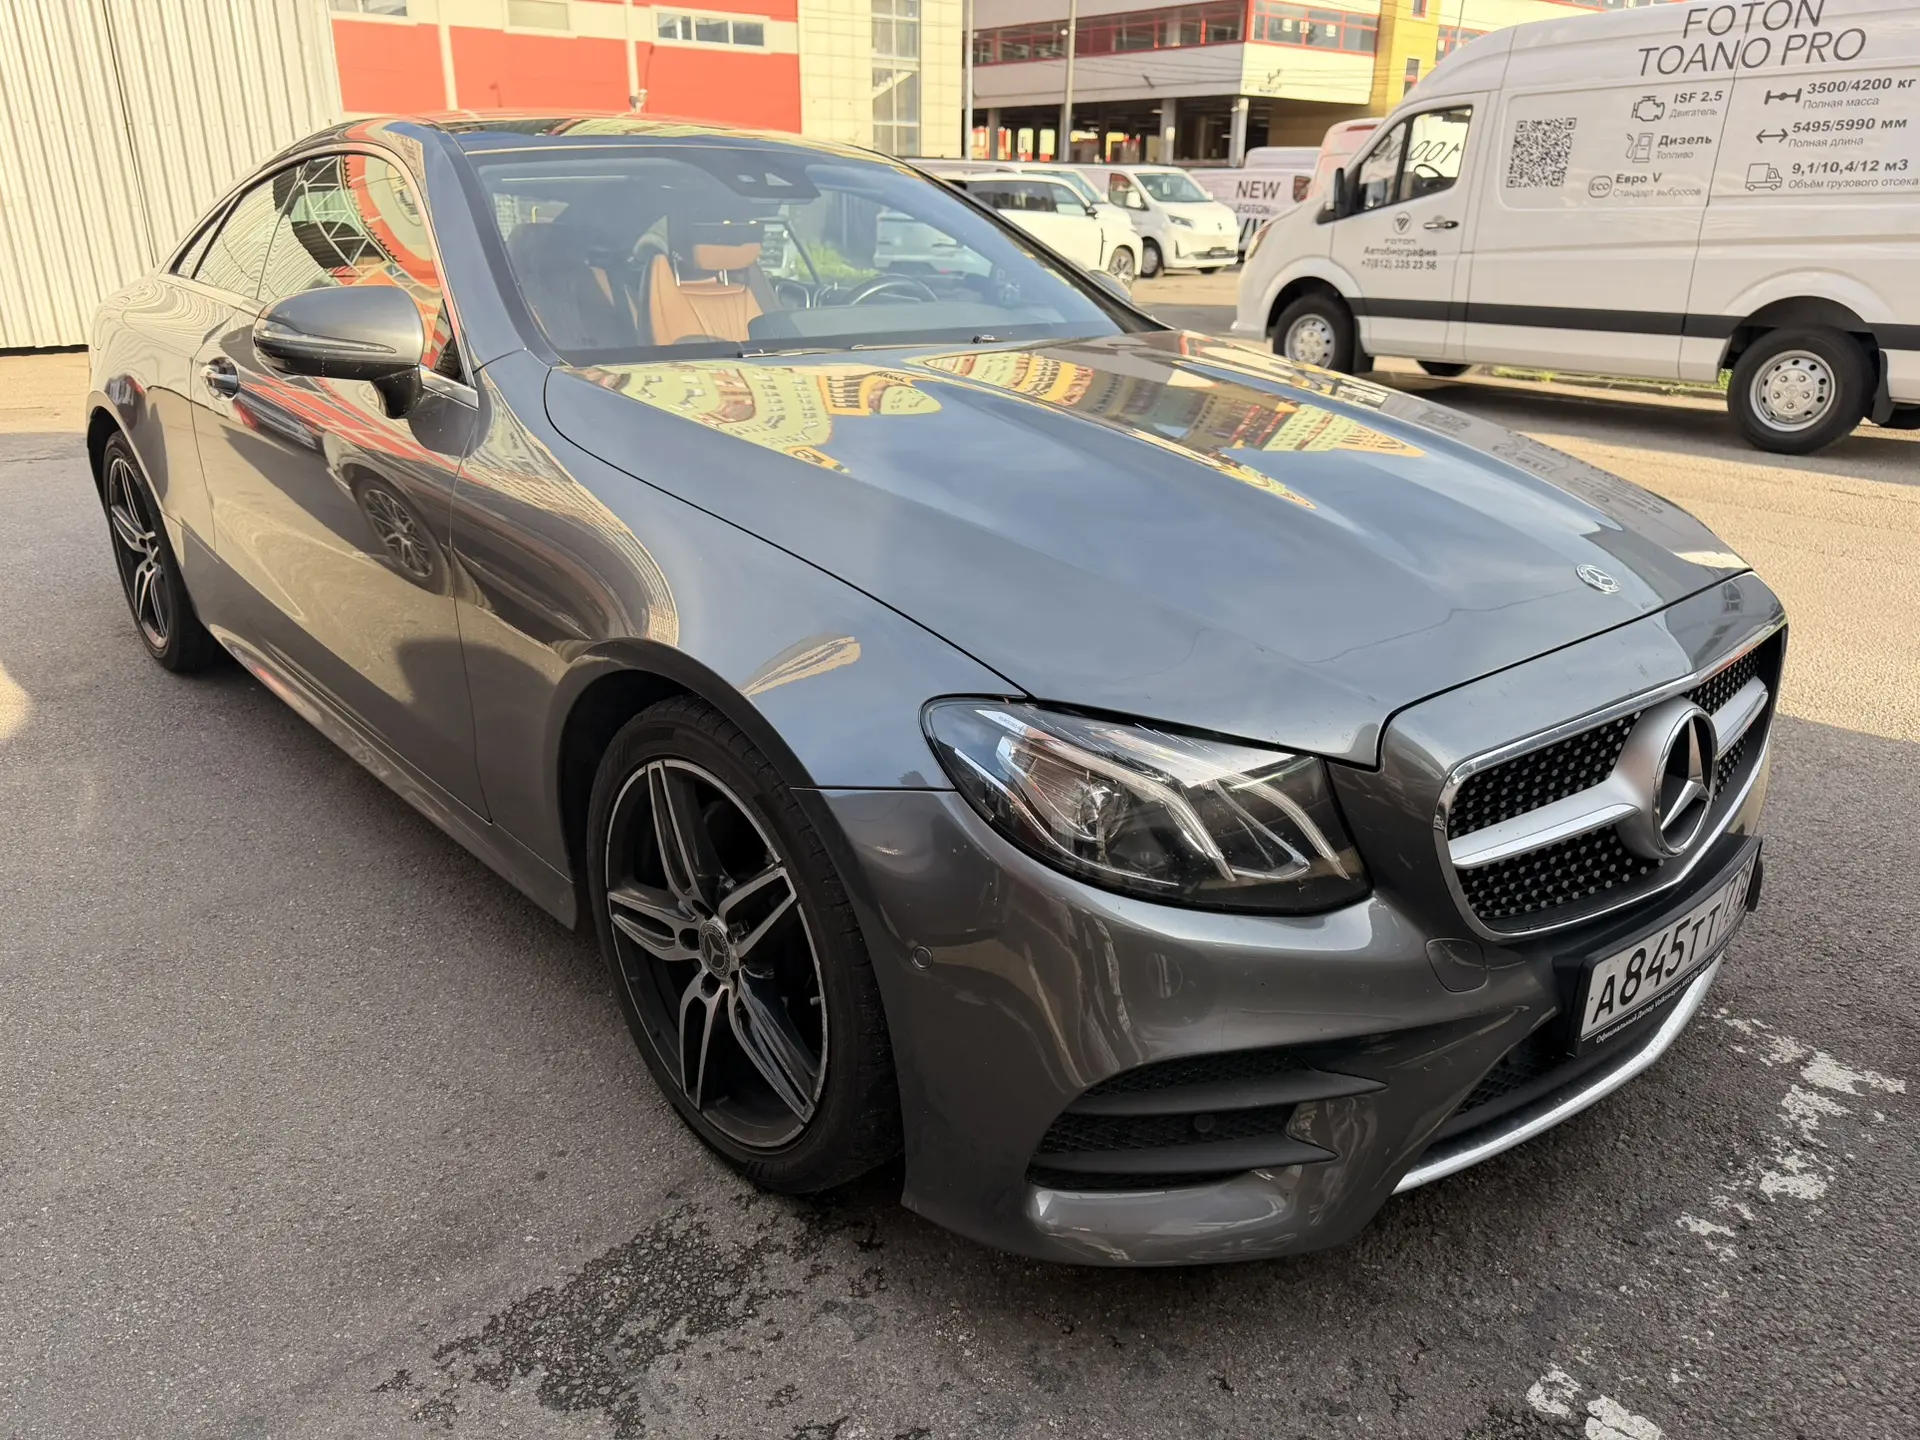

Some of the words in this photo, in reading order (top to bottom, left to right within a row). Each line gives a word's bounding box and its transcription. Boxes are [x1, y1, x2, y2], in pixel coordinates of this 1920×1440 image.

[1683, 0, 1826, 39] FOTON
[1638, 36, 1772, 77] TOANO
[1780, 28, 1867, 66] PRO
[1806, 77, 1893, 94] 3500/4200
[1897, 78, 1917, 89] кг
[1673, 91, 1698, 104] ISF
[1700, 90, 1723, 103] 2.5
[1802, 98, 1843, 110] Полная
[1845, 97, 1880, 108] масса
[1669, 108, 1718, 119] Двигатель
[1791, 117, 1876, 133] 5495/5990
[1880, 118, 1908, 130] мм
[1657, 134, 1713, 148] Дизель
[1788, 138, 1828, 149] Полная
[1829, 136, 1864, 148] длина
[1656, 150, 1694, 160] Топливо
[1791, 159, 1880, 176] 9,1/10,4/12
[1884, 158, 1909, 172] м3
[1615, 173, 1648, 186] Евро
[1652, 172, 1663, 183] V
[1826, 178, 1879, 192] грузового
[1880, 177, 1919, 188] отсека
[1235, 180, 1281, 199] NEW
[1590, 182, 1611, 192] ECO
[1613, 188, 1654, 198] Стандарт
[1656, 186, 1702, 197] выбросов
